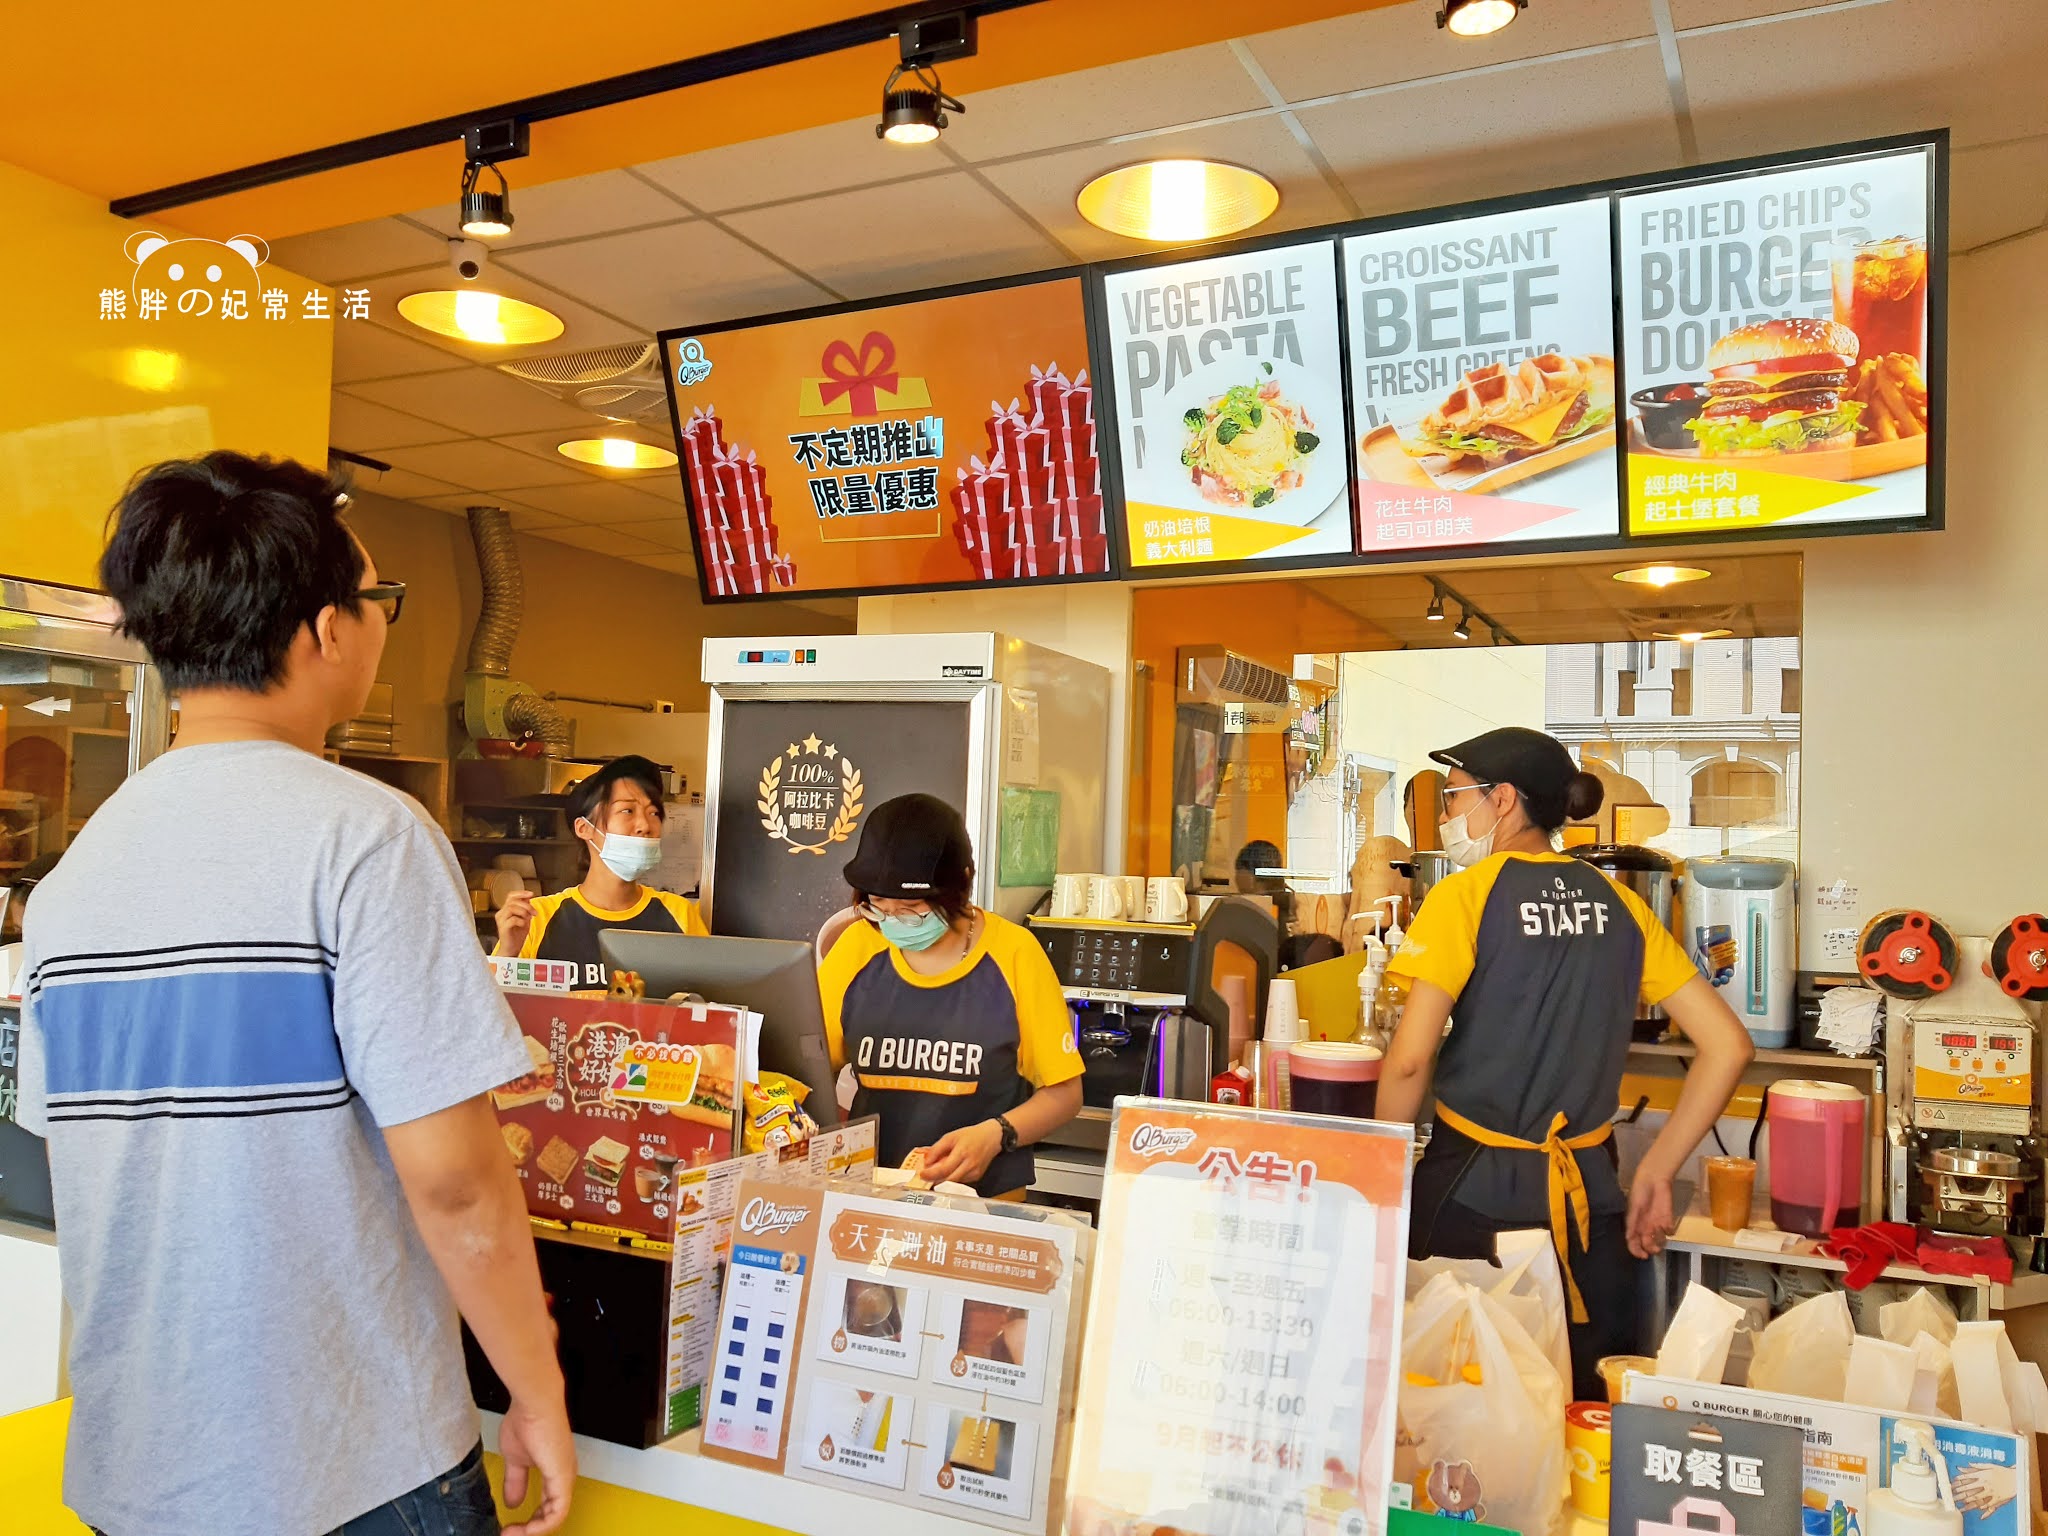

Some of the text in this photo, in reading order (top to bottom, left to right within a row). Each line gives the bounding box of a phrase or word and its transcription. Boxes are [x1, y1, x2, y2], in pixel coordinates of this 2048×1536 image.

[1641, 181, 1872, 247] FRIED CHIPS
[1359, 227, 1559, 285] CROISSANT
[1121, 264, 1306, 336] VEGETABLE
[1361, 265, 1560, 359] BEEF
[1366, 357, 1448, 399] FRESH
[788, 416, 944, 473] 不定期推出
[809, 467, 939, 519] 限量優惠
[1643, 470, 1738, 498] 經典牛肉
[1374, 495, 1453, 518] 花生牛肉
[1644, 495, 1761, 523] 起士堡套餐
[1143, 517, 1211, 539] 奶油培根
[1375, 517, 1474, 541] 起司可朗芙
[787, 763, 836, 784] 100%
[783, 790, 836, 810] 阿拉比卡
[788, 812, 828, 831] 咖啡豆
[1519, 901, 1610, 937] STAFF
[858, 1036, 984, 1076] Q BURGER
[1133, 1125, 1193, 1152] QBurger
[1198, 1150, 1314, 1204] 公告!
[740, 1196, 812, 1236] QBurger
[1192, 1211, 1306, 1252] 營業時間
[998, 1246, 1039, 1264] 把關品質
[1181, 1264, 1306, 1305] 週一至週五
[1181, 1338, 1292, 1379] 週六/週日
[1692, 1400, 1814, 1427] Q BURGER 關心您的健康
[1643, 1442, 1766, 1497] 取餐區
